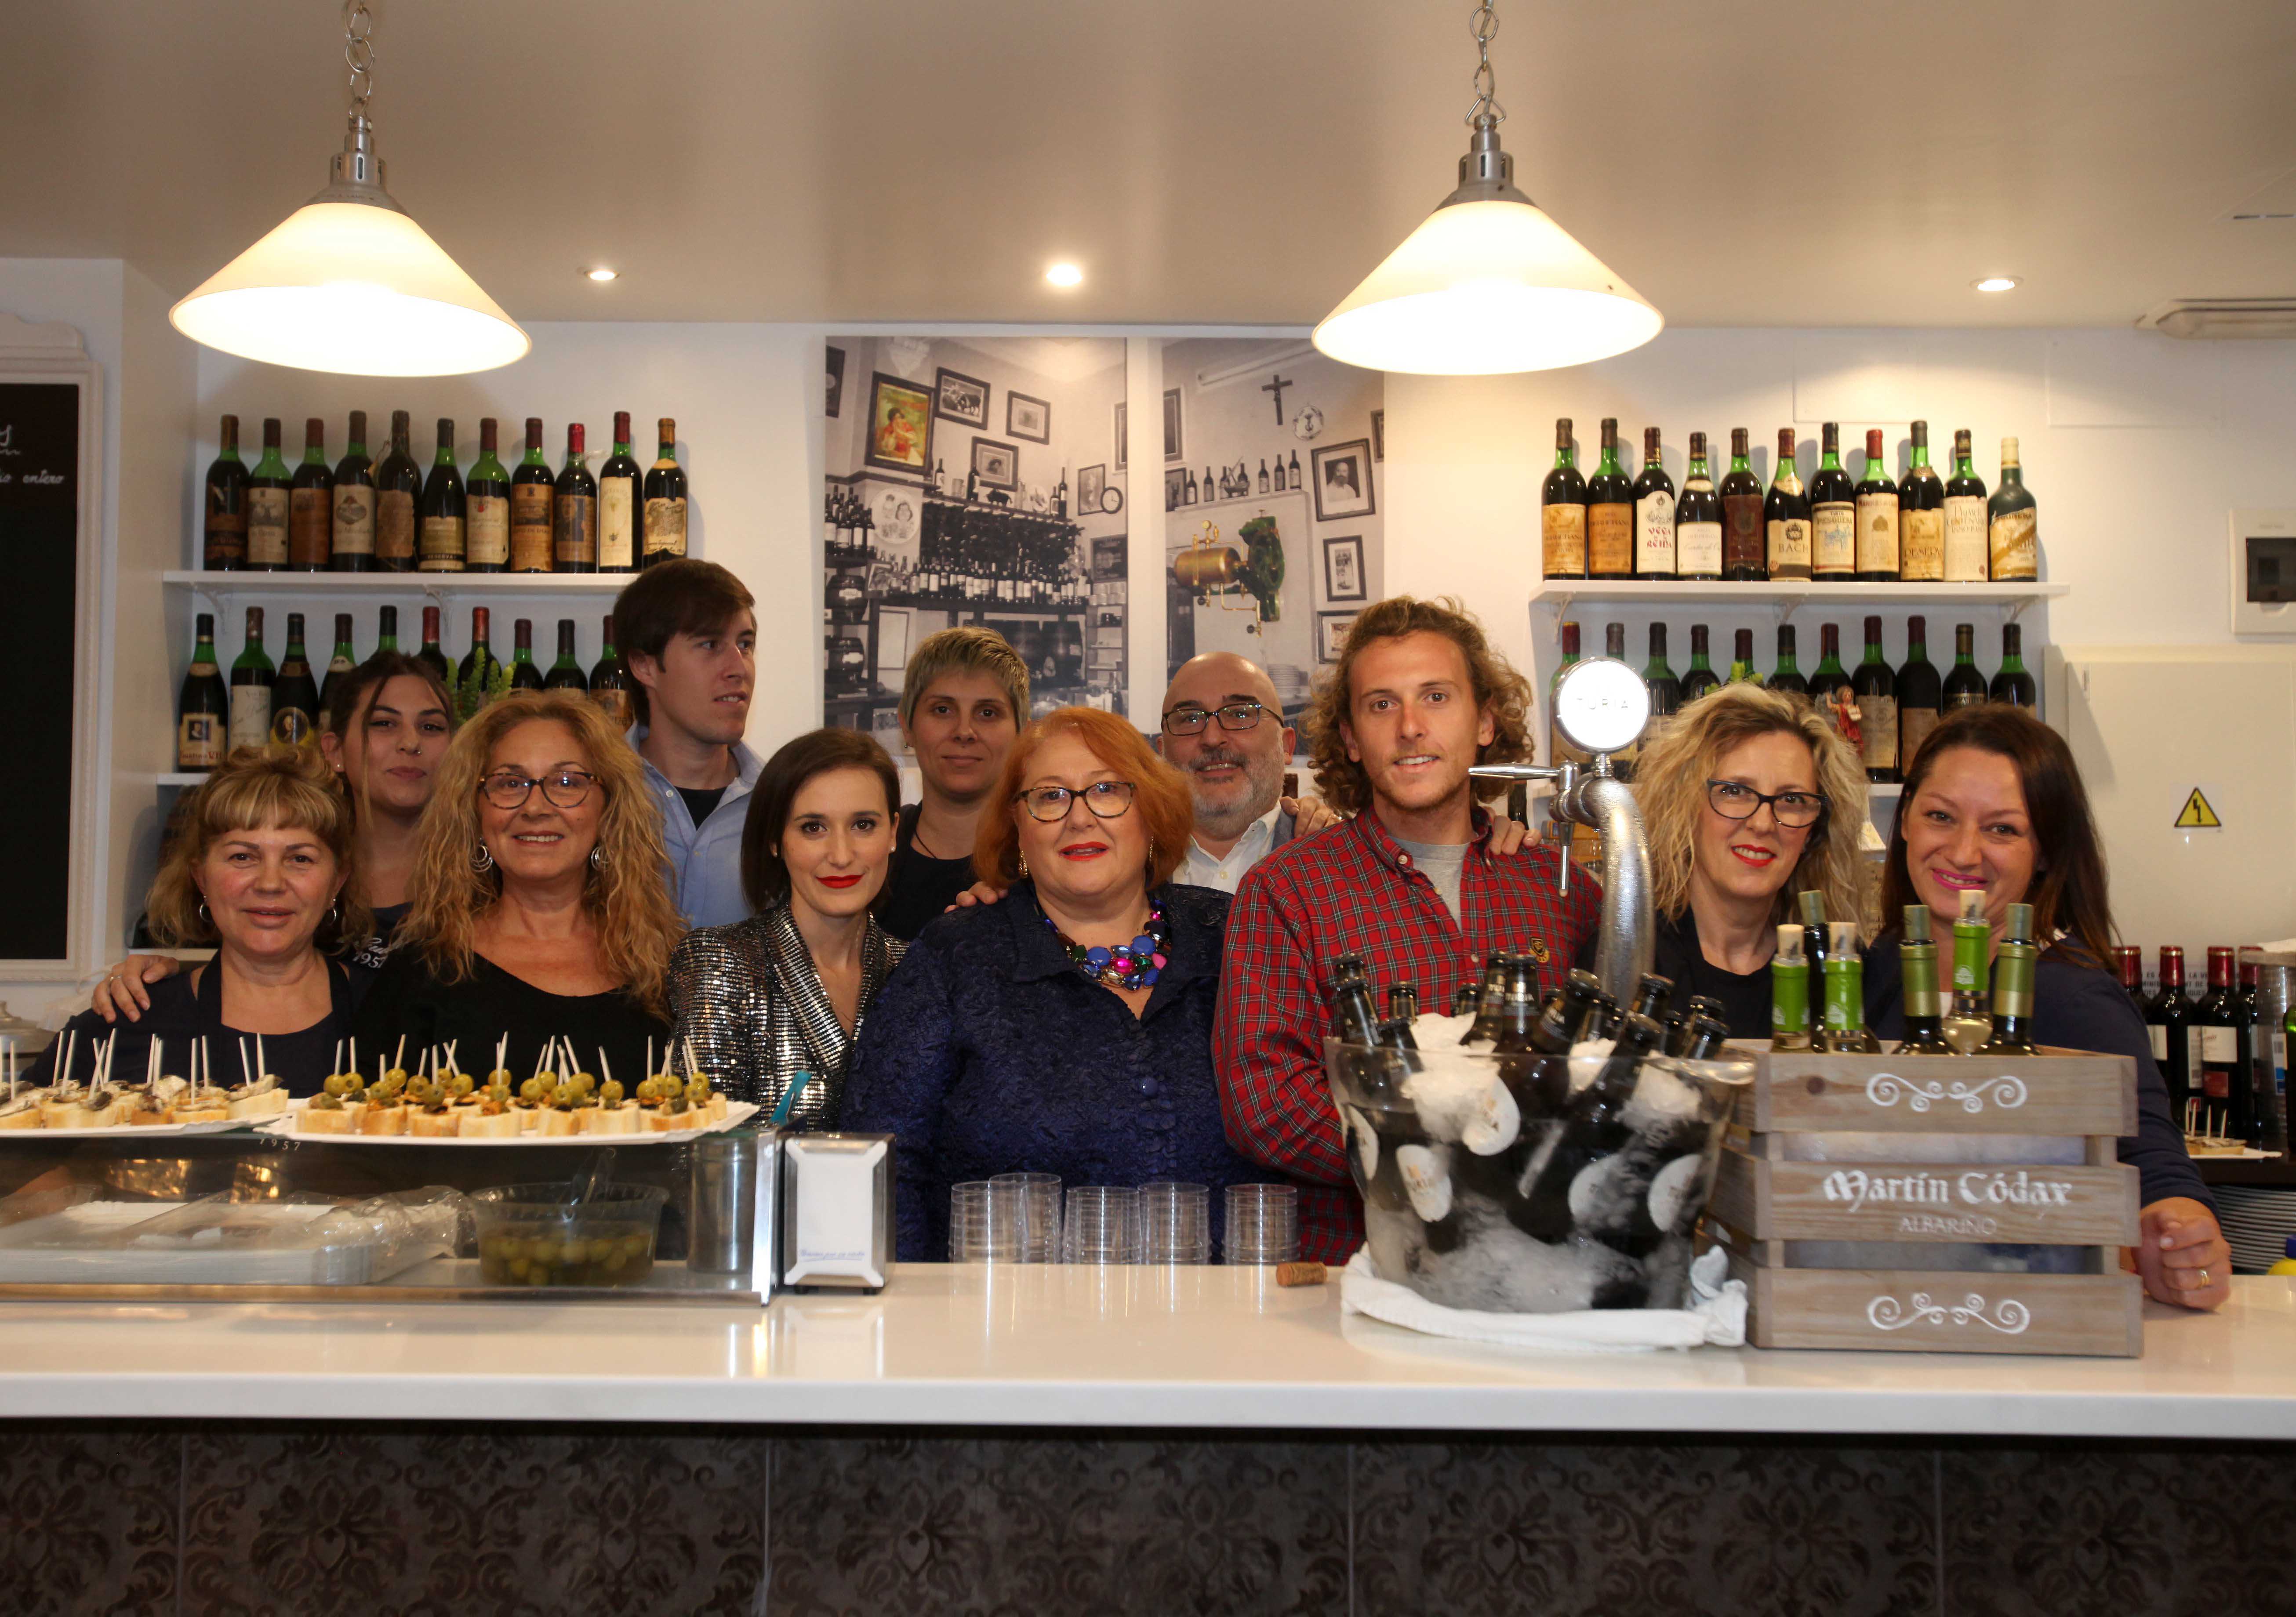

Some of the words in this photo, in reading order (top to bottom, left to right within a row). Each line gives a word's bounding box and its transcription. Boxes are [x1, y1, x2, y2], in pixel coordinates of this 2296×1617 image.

[1778, 543, 1808, 553] BACH
[1822, 1169, 1949, 1212] Martín
[1898, 1215, 1998, 1235] ALBARIÑO
